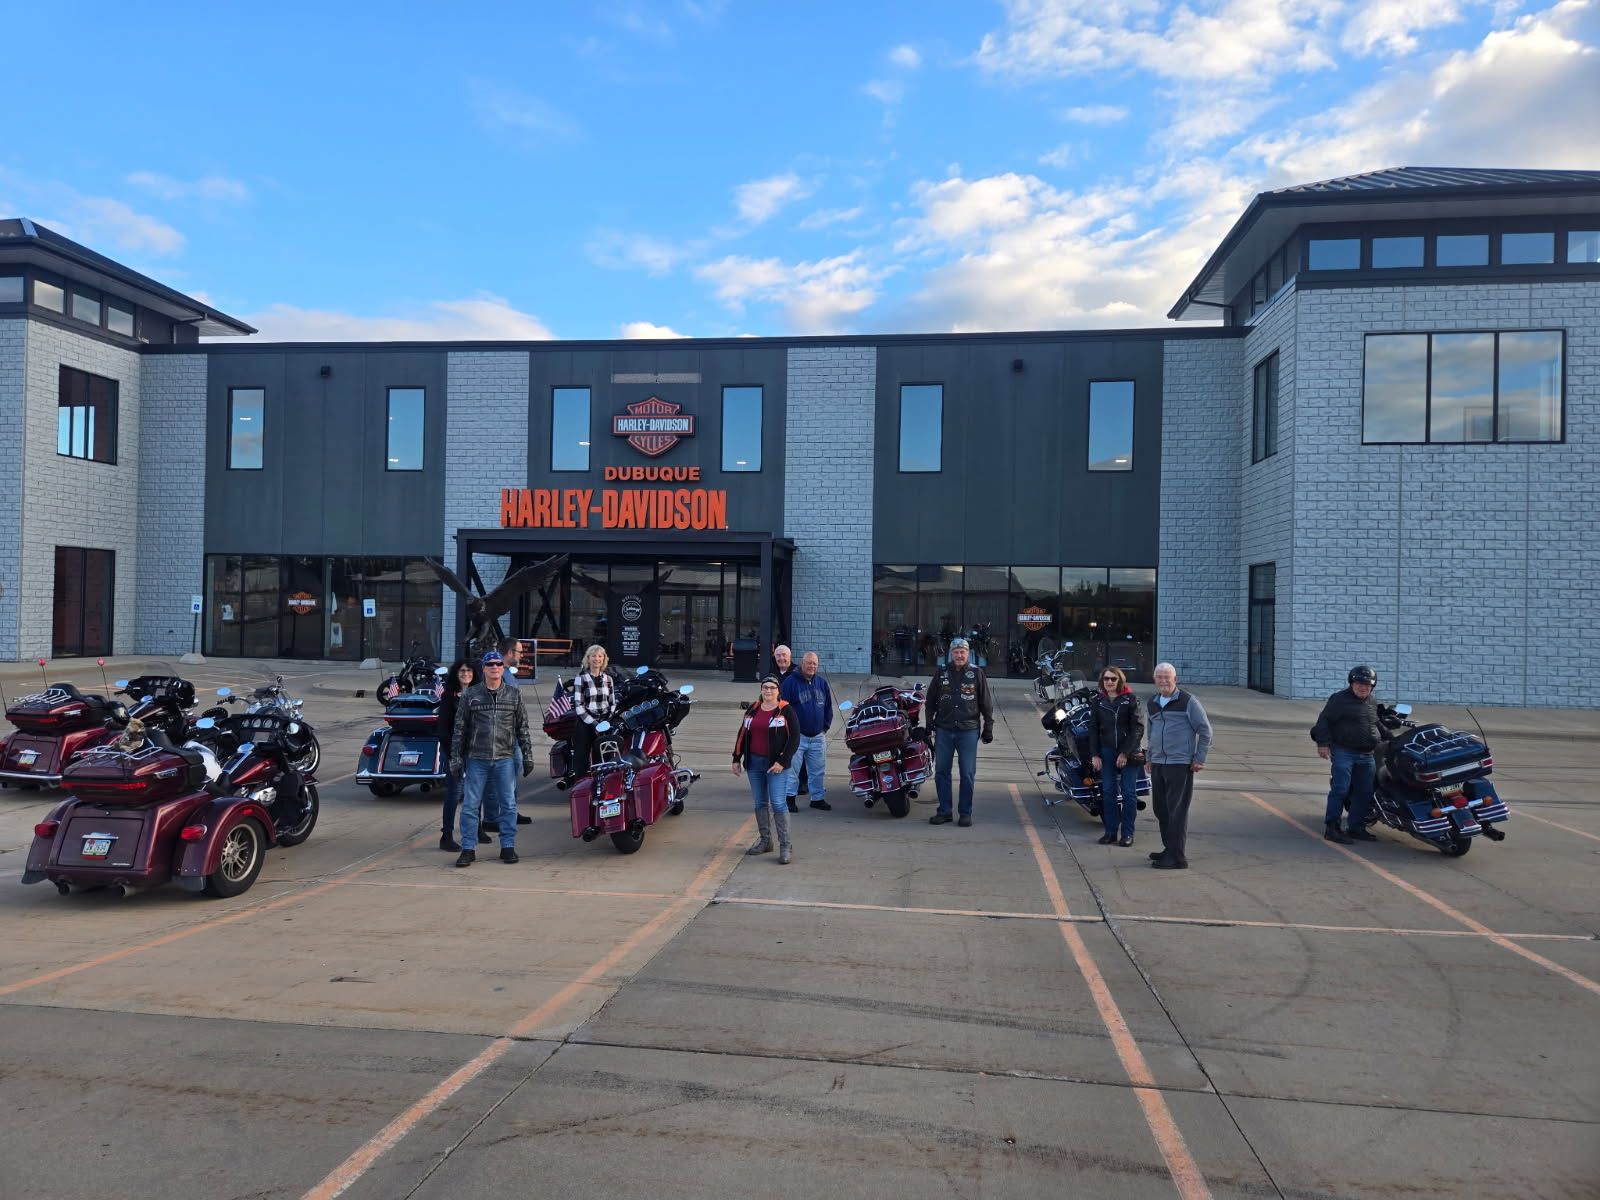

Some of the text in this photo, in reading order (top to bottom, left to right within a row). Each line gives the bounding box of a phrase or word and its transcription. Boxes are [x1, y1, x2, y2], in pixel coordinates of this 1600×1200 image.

[634, 401, 672, 414] MOTOR
[617, 418, 689, 431] HARLEY-DAVIDSON
[634, 435, 671, 451] CYCLES
[604, 466, 701, 482] DUBUQUE
[500, 488, 727, 530] HARLEY-DAVIDSON
